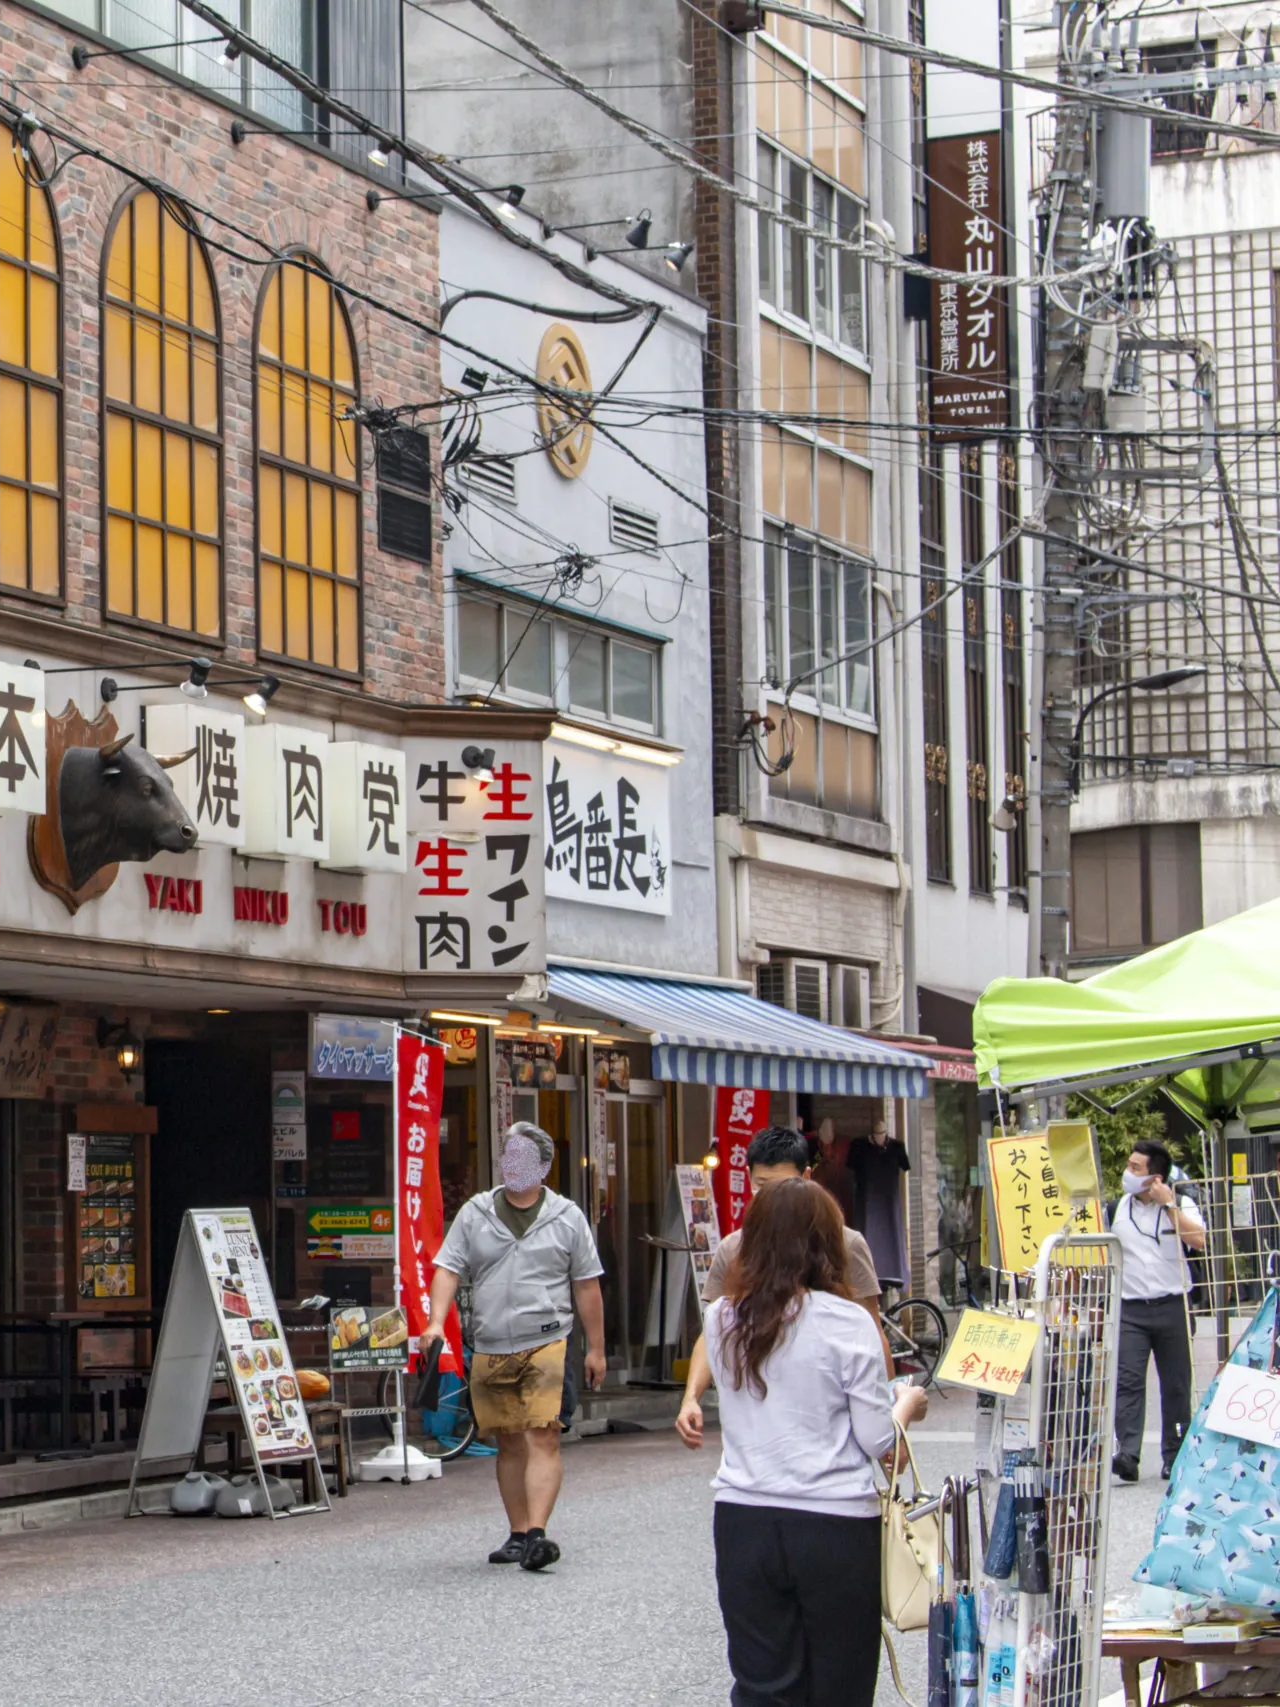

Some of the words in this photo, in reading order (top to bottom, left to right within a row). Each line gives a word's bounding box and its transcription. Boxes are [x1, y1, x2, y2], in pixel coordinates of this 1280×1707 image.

[939, 283, 959, 372] 東京営業所
[934, 389, 1006, 405] MARUYAMA
[949, 405, 990, 417] TOWEL
[415, 760, 472, 970] 牛生肉
[479, 762, 533, 968] 生ワイン
[545, 755, 651, 898] 鳥番長
[144, 873, 203, 915] YAKI
[233, 885, 289, 926] NIKU
[318, 899, 367, 936] TOU
[373, 1213, 391, 1228] 4F
[728, 1143, 747, 1230] お届け
